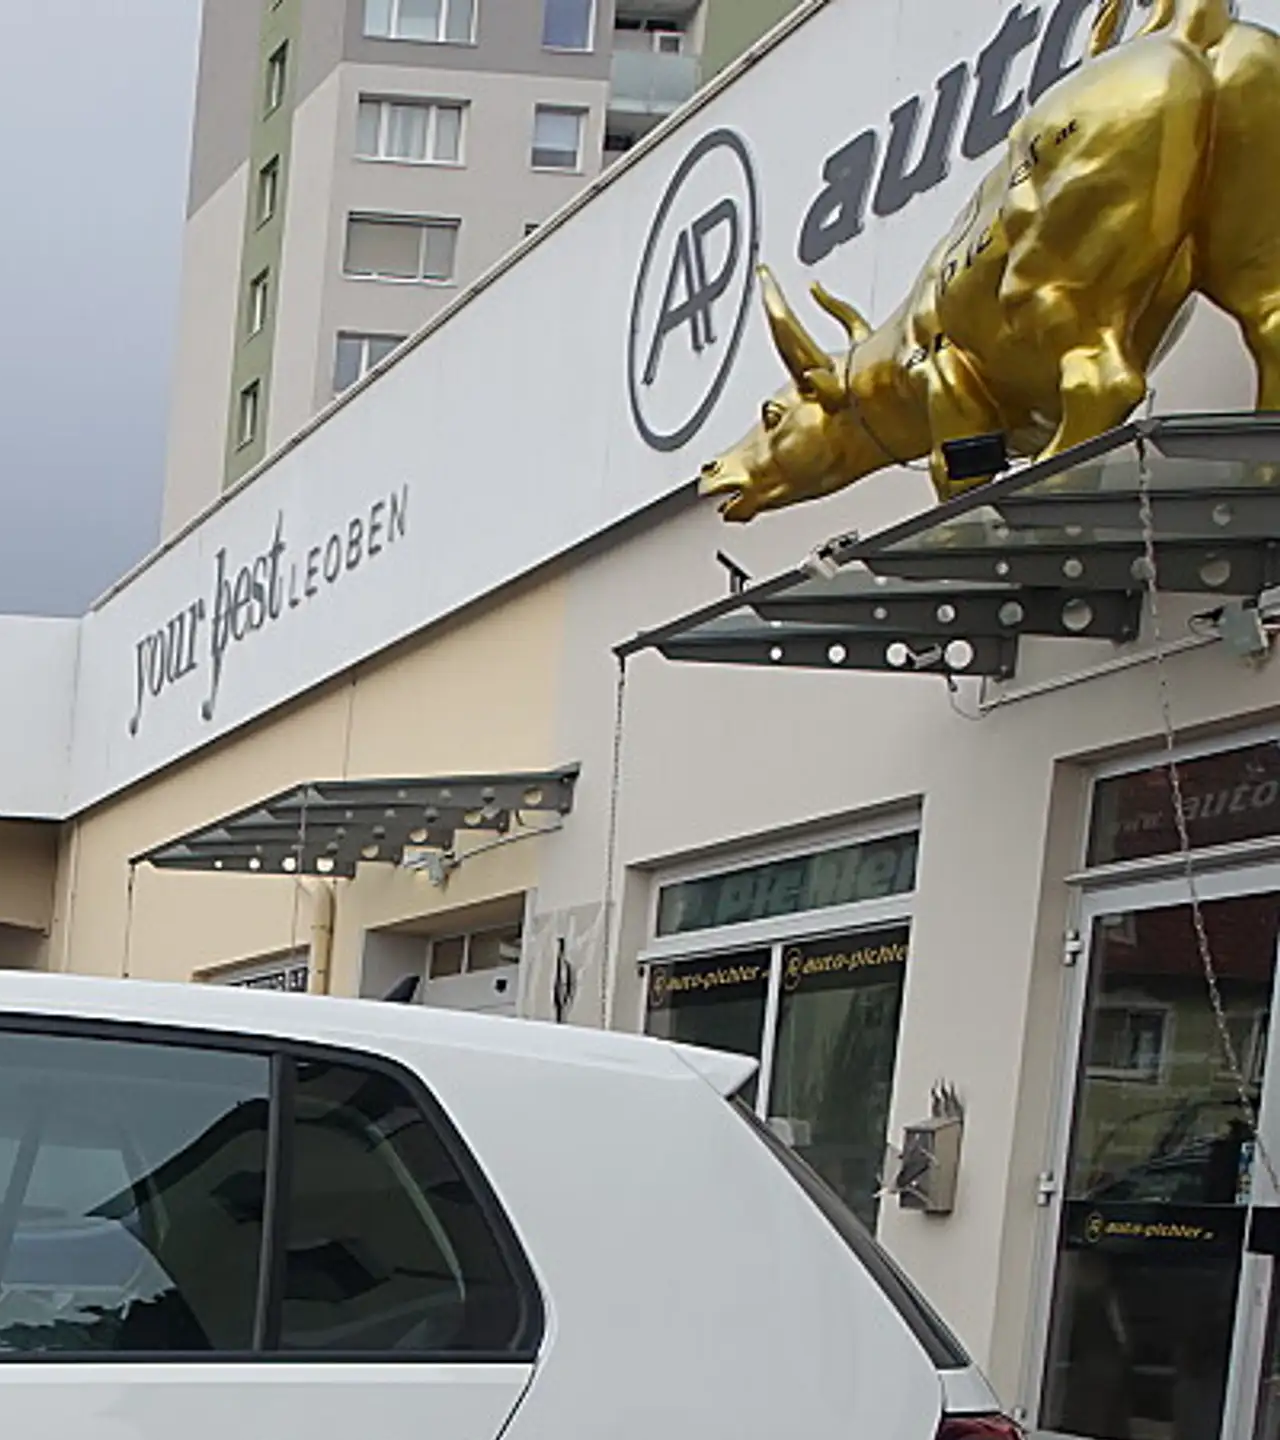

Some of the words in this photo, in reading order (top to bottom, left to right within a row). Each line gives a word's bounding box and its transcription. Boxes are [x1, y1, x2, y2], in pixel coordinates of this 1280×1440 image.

[129, 597, 206, 737] your
[201, 508, 286, 721] best
[288, 483, 409, 609] LEOBEN
